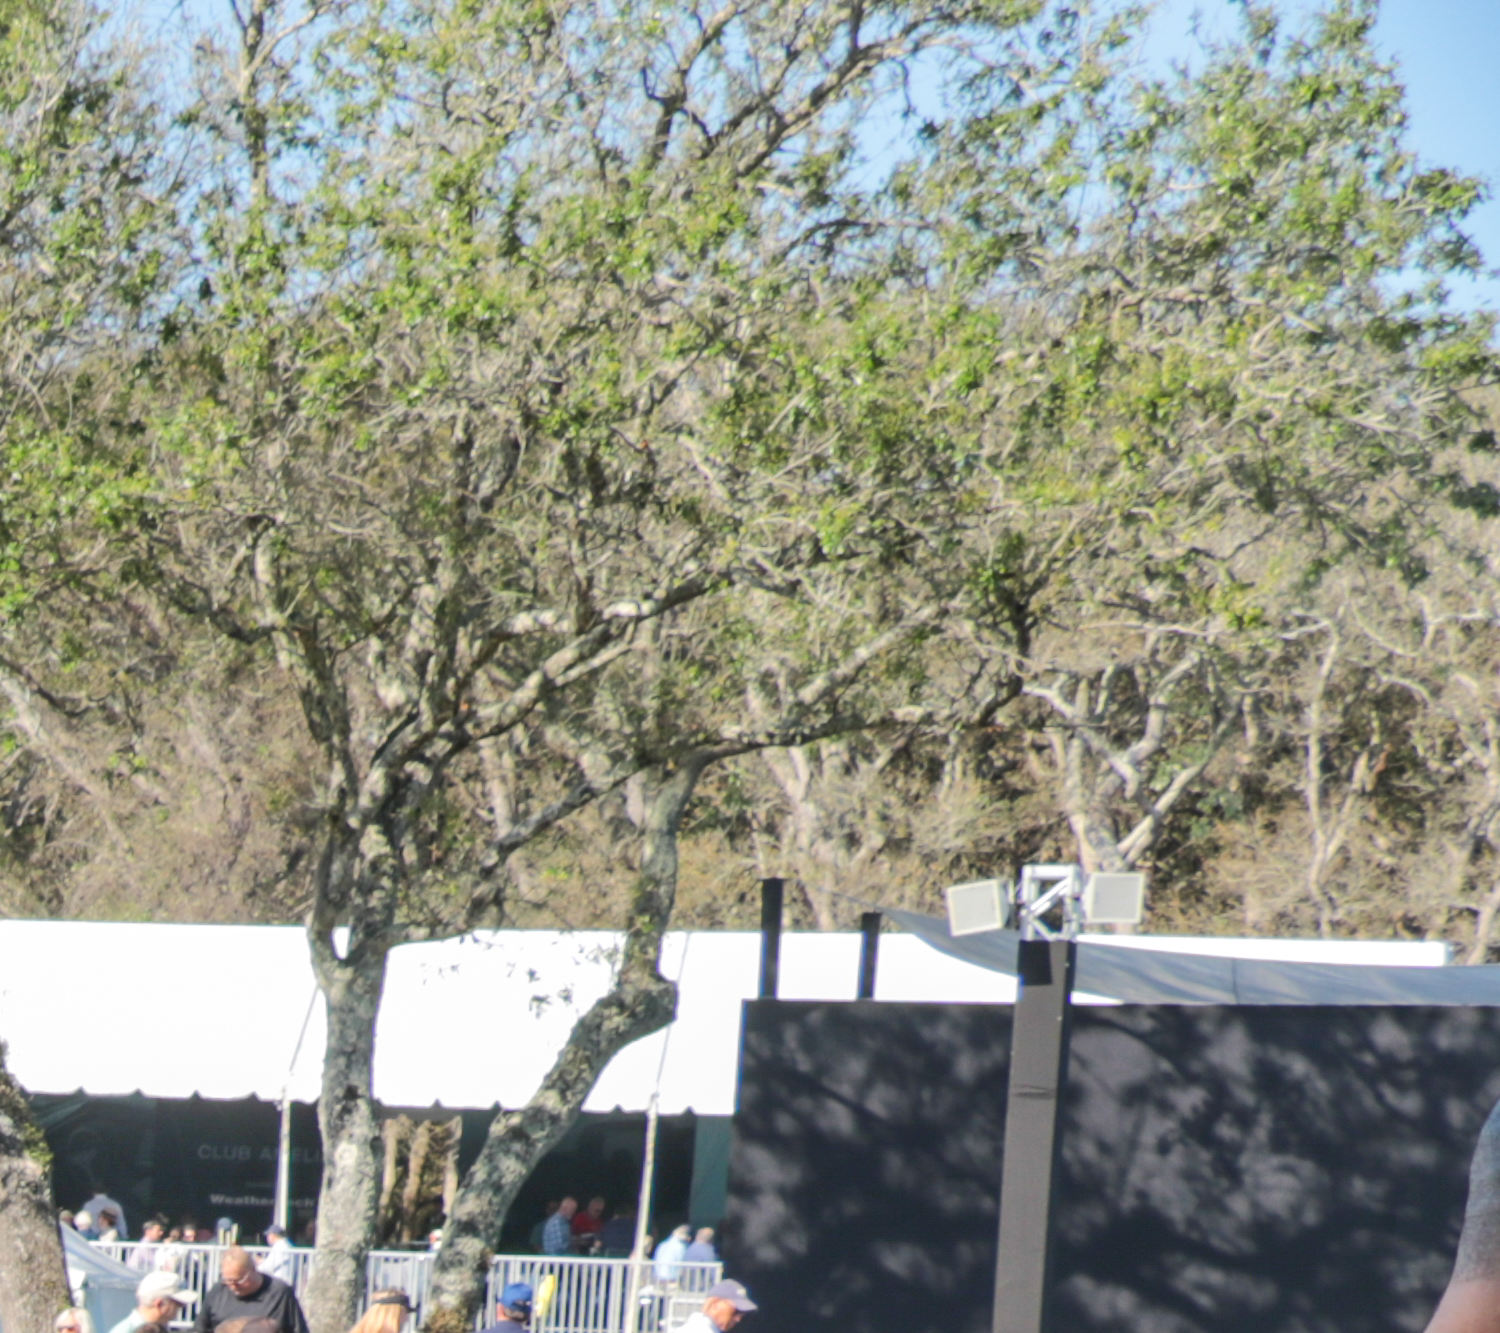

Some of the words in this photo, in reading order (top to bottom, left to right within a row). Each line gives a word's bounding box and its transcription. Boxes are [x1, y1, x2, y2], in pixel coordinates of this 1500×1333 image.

[197, 1144, 252, 1161] CLUB
[258, 1147, 324, 1163] AELI
[209, 1193, 316, 1208] Weatherech
